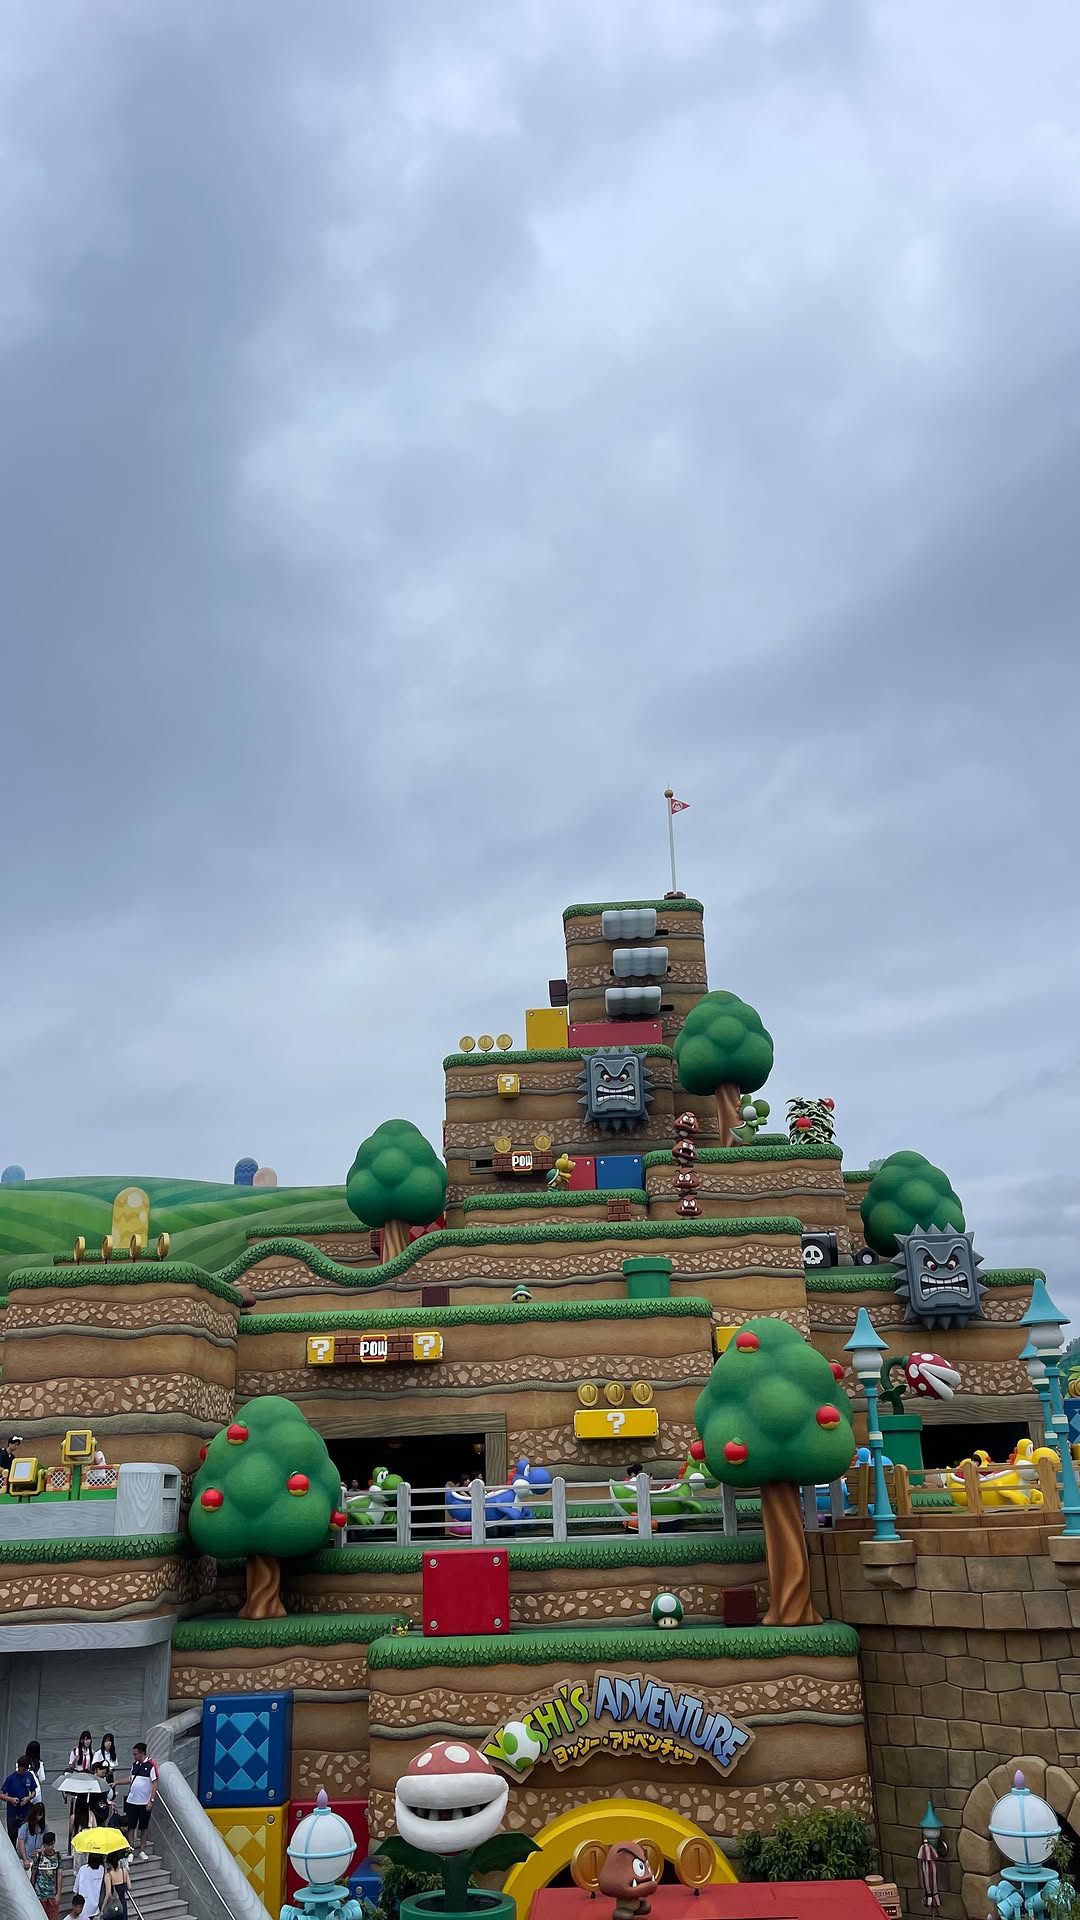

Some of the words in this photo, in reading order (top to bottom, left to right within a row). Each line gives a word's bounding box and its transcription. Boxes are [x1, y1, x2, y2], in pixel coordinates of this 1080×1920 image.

[501, 1076, 515, 1090] ?
[512, 1155, 532, 1167] POW
[312, 1339, 330, 1361] ?
[360, 1341, 388, 1356] POW
[417, 1335, 436, 1357] ?
[607, 1412, 625, 1434] ?
[594, 1676, 749, 1767] ADVENTURE
[553, 1730, 694, 1765] ヨッシー・アドベンチャー
